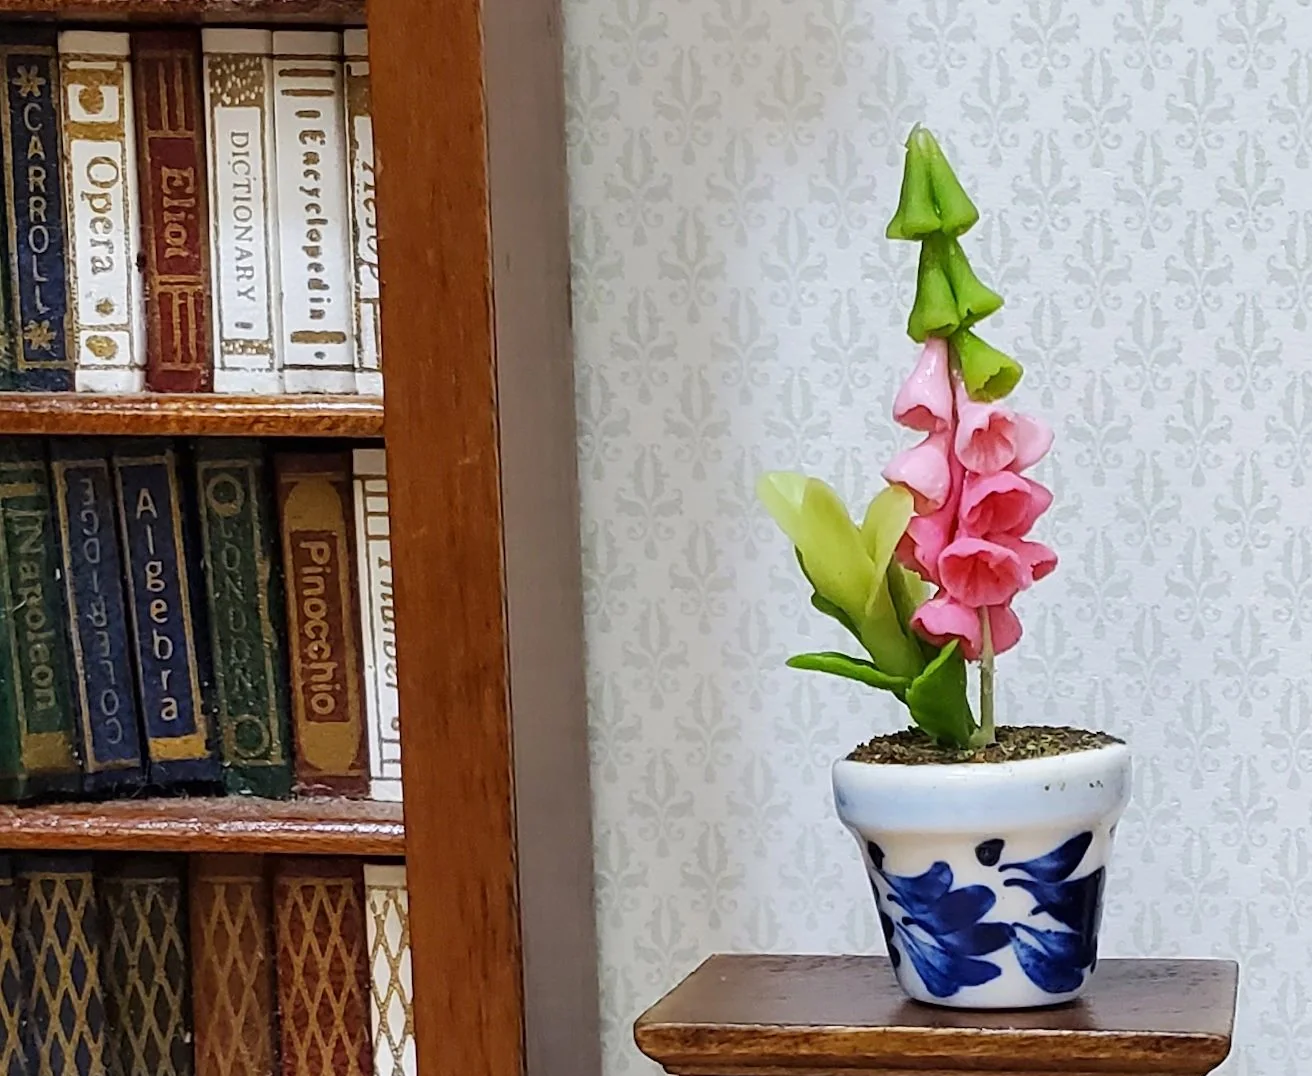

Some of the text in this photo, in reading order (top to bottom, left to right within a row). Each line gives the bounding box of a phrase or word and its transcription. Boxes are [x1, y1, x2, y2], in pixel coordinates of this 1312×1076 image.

[23, 102, 50, 315] CARROLL
[80, 155, 120, 276] Opera
[161, 165, 196, 259] Eliot
[229, 130, 257, 303] DICTIONARY
[13, 515, 57, 710] Napoleon
[79, 478, 123, 745] COLERIDGE
[136, 487, 178, 721] Algebra
[299, 540, 341, 715] Pinocchio
